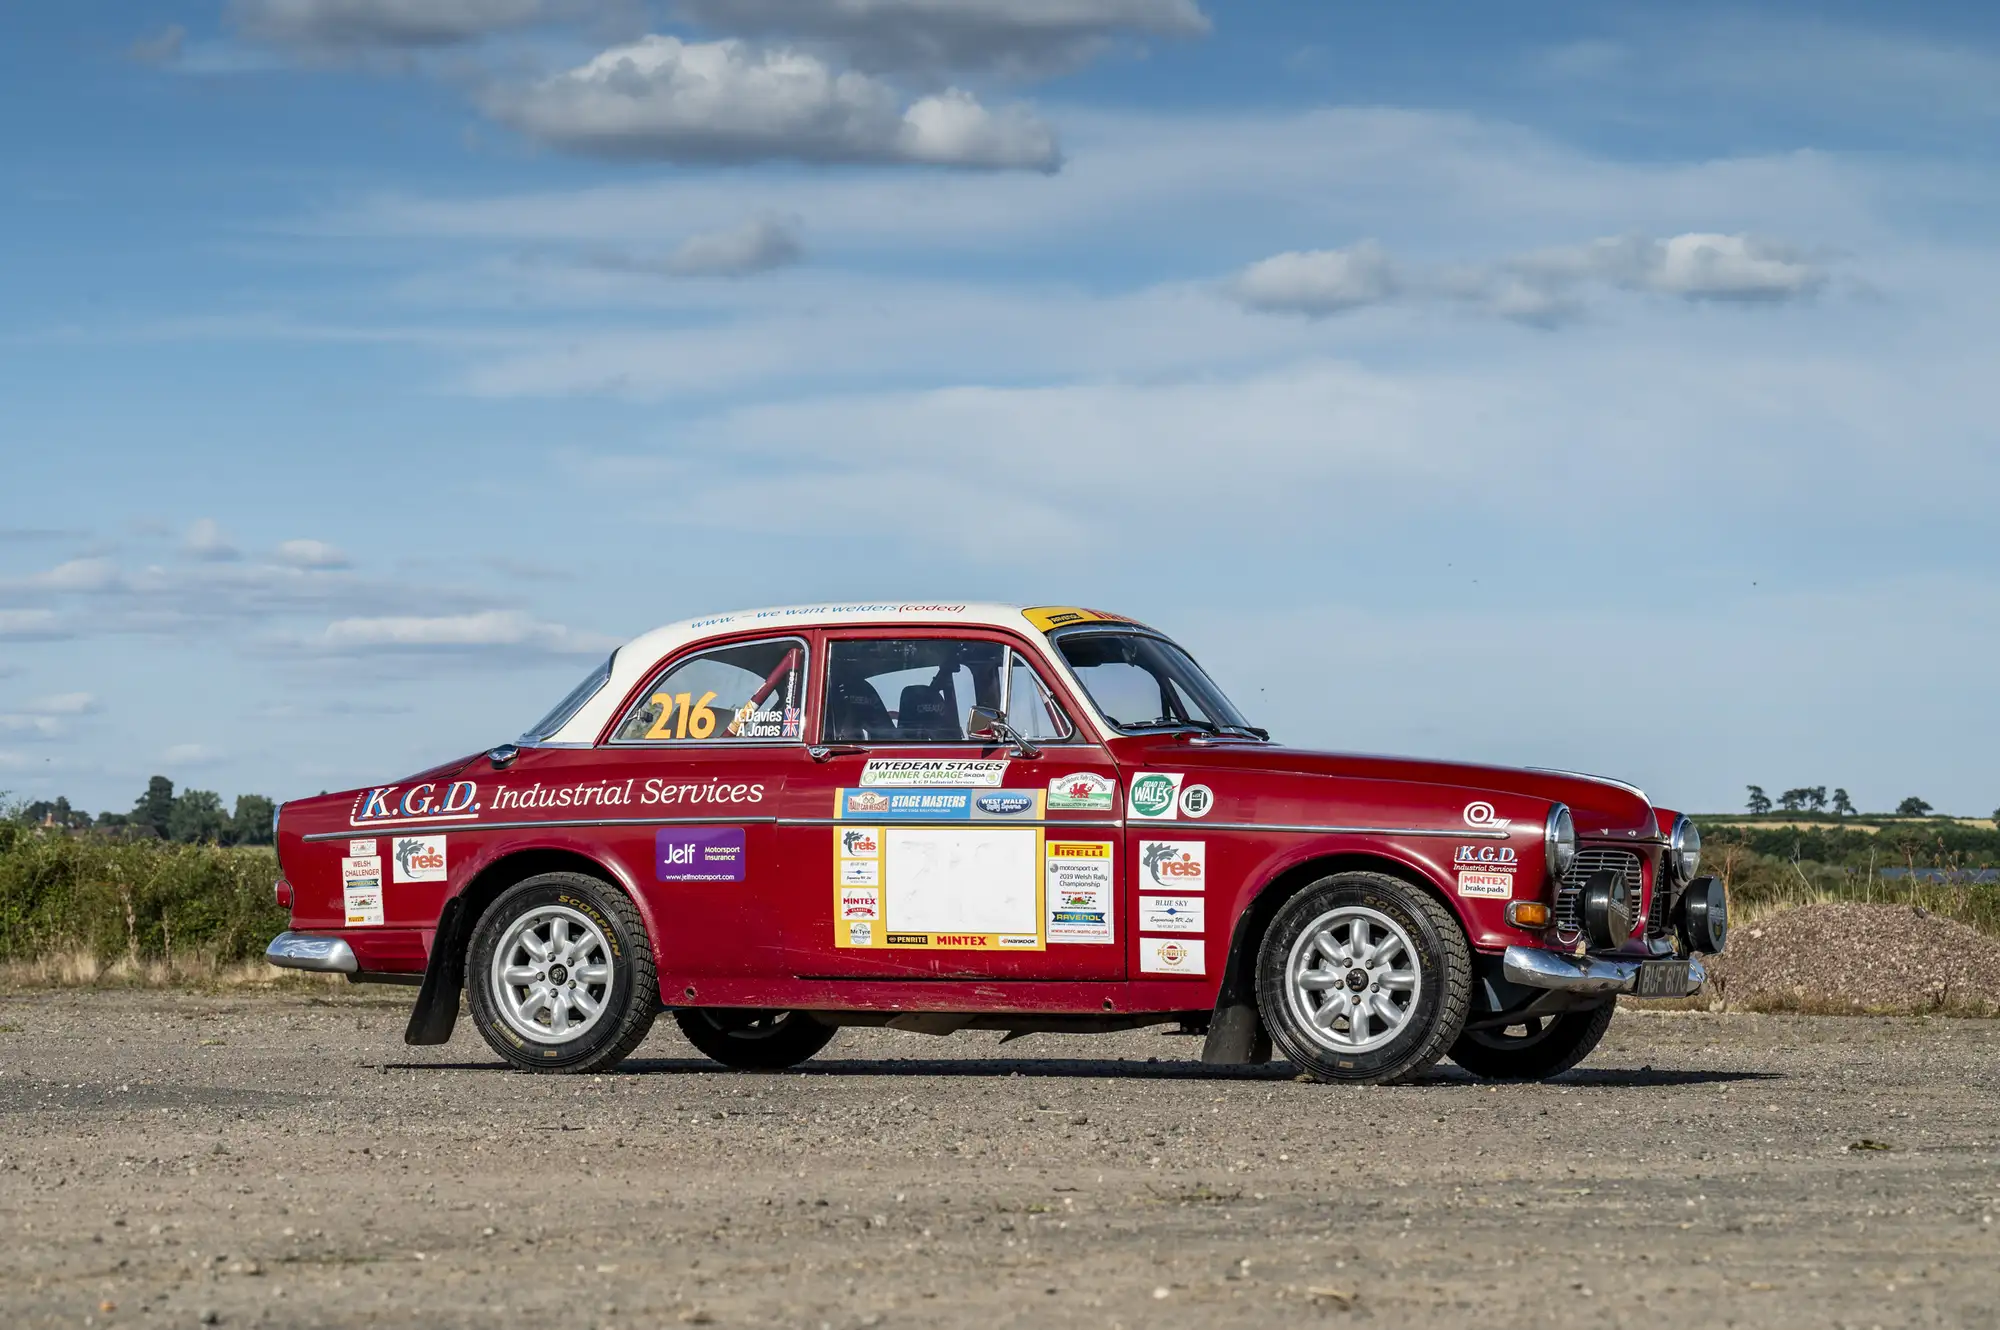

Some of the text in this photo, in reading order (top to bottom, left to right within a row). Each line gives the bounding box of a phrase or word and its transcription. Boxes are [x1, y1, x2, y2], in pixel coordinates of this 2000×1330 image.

[785, 606, 828, 615] want
[645, 691, 718, 739] 216
[736, 723, 781, 737] A Jones
[869, 762, 1004, 770] WYEDEAN STAGES
[358, 776, 764, 820] K.G.D. Industrial Services
[1134, 786, 1169, 803] WALES
[892, 796, 966, 808] STAGE MASTERS
[854, 836, 876, 850] reis
[1054, 844, 1104, 856] PIRELLI
[411, 846, 444, 869] reis
[664, 844, 696, 864] Jelf
[1458, 845, 1519, 863] K.G.D.
[1162, 852, 1202, 876] reis
[1453, 864, 1517, 873] Industrial Services
[345, 869, 380, 877] CHALLENGER
[1060, 880, 1100, 888] Championship
[1463, 876, 1507, 886] MINTEX
[1465, 884, 1486, 892] brake
[558, 895, 622, 957] SCORPION
[936, 936, 987, 945] MINTEX
[1642, 964, 1688, 993] BUF 617C
